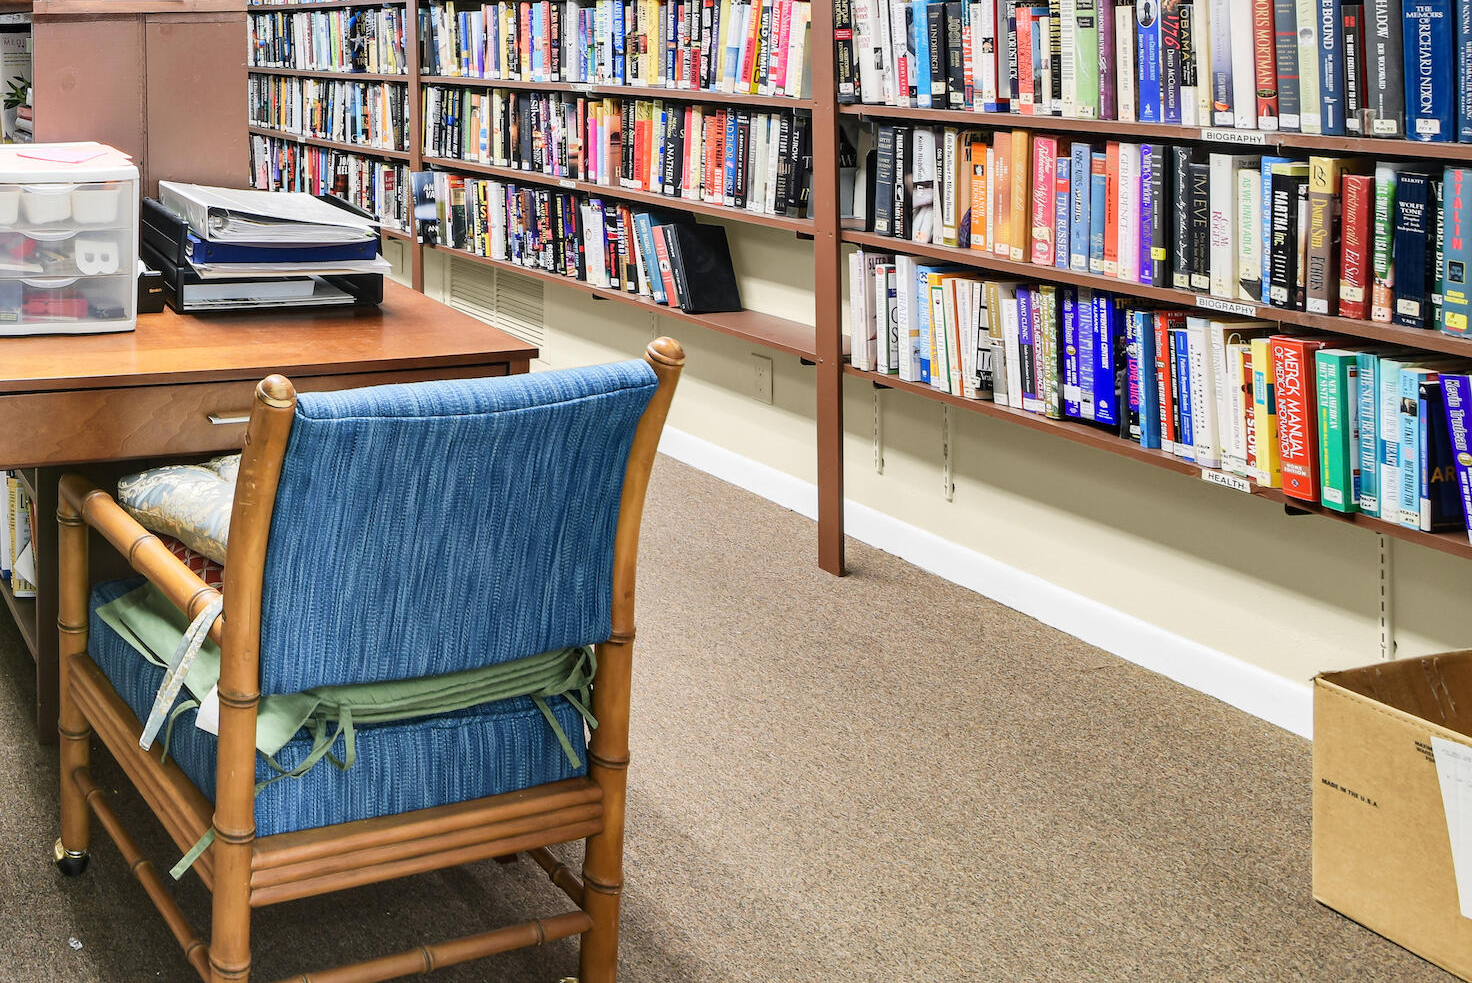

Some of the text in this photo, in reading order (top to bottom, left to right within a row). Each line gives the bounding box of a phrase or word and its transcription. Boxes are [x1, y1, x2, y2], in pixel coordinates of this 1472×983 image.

[760, 13, 769, 77] WILD ANIMUS
[931, 24, 939, 74] LINDBERGH
[1008, 31, 1018, 79] WORDSTRUCK
[1162, 15, 1180, 50] 1776
[1180, 9, 1191, 61] OBAMA
[1323, 8, 1333, 49] BOUND
[1167, 49, 1176, 108] DAVID McCULLOUGH
[1256, 29, 1272, 85] MORTMAN
[1418, 24, 1433, 113] RICHARD NIXON
[665, 142, 674, 183] ANATHEM
[917, 135, 925, 182] Keith Richards
[1206, 131, 1263, 144] BIOGRAPHY
[1193, 173, 1207, 227] I'M EVE
[1274, 191, 1288, 246] MARTHA inc.
[1346, 177, 1361, 262] Christmas with Ed
[1453, 171, 1464, 250] STALIN
[1057, 195, 1067, 265] TIM RUSSERT
[1311, 255, 1327, 291] ECHOES
[1199, 297, 1255, 315] BIOGRAPHY
[1274, 346, 1290, 458] OF MEDICAL INFORMATION
[1284, 349, 1304, 459] MERCK MANUAL
[1319, 362, 1328, 406] DIET SYSTEM
[1328, 363, 1338, 430] THE NEW AMERICAN
[1246, 418, 1257, 456] SLOW
[1361, 368, 1375, 474] THE SOUTH BEACH DIET
[1444, 379, 1467, 450] Kevin Trudeau
[1208, 472, 1245, 490] HEALTH
[1321, 778, 1338, 791] MADE
[1348, 789, 1358, 798] THE
